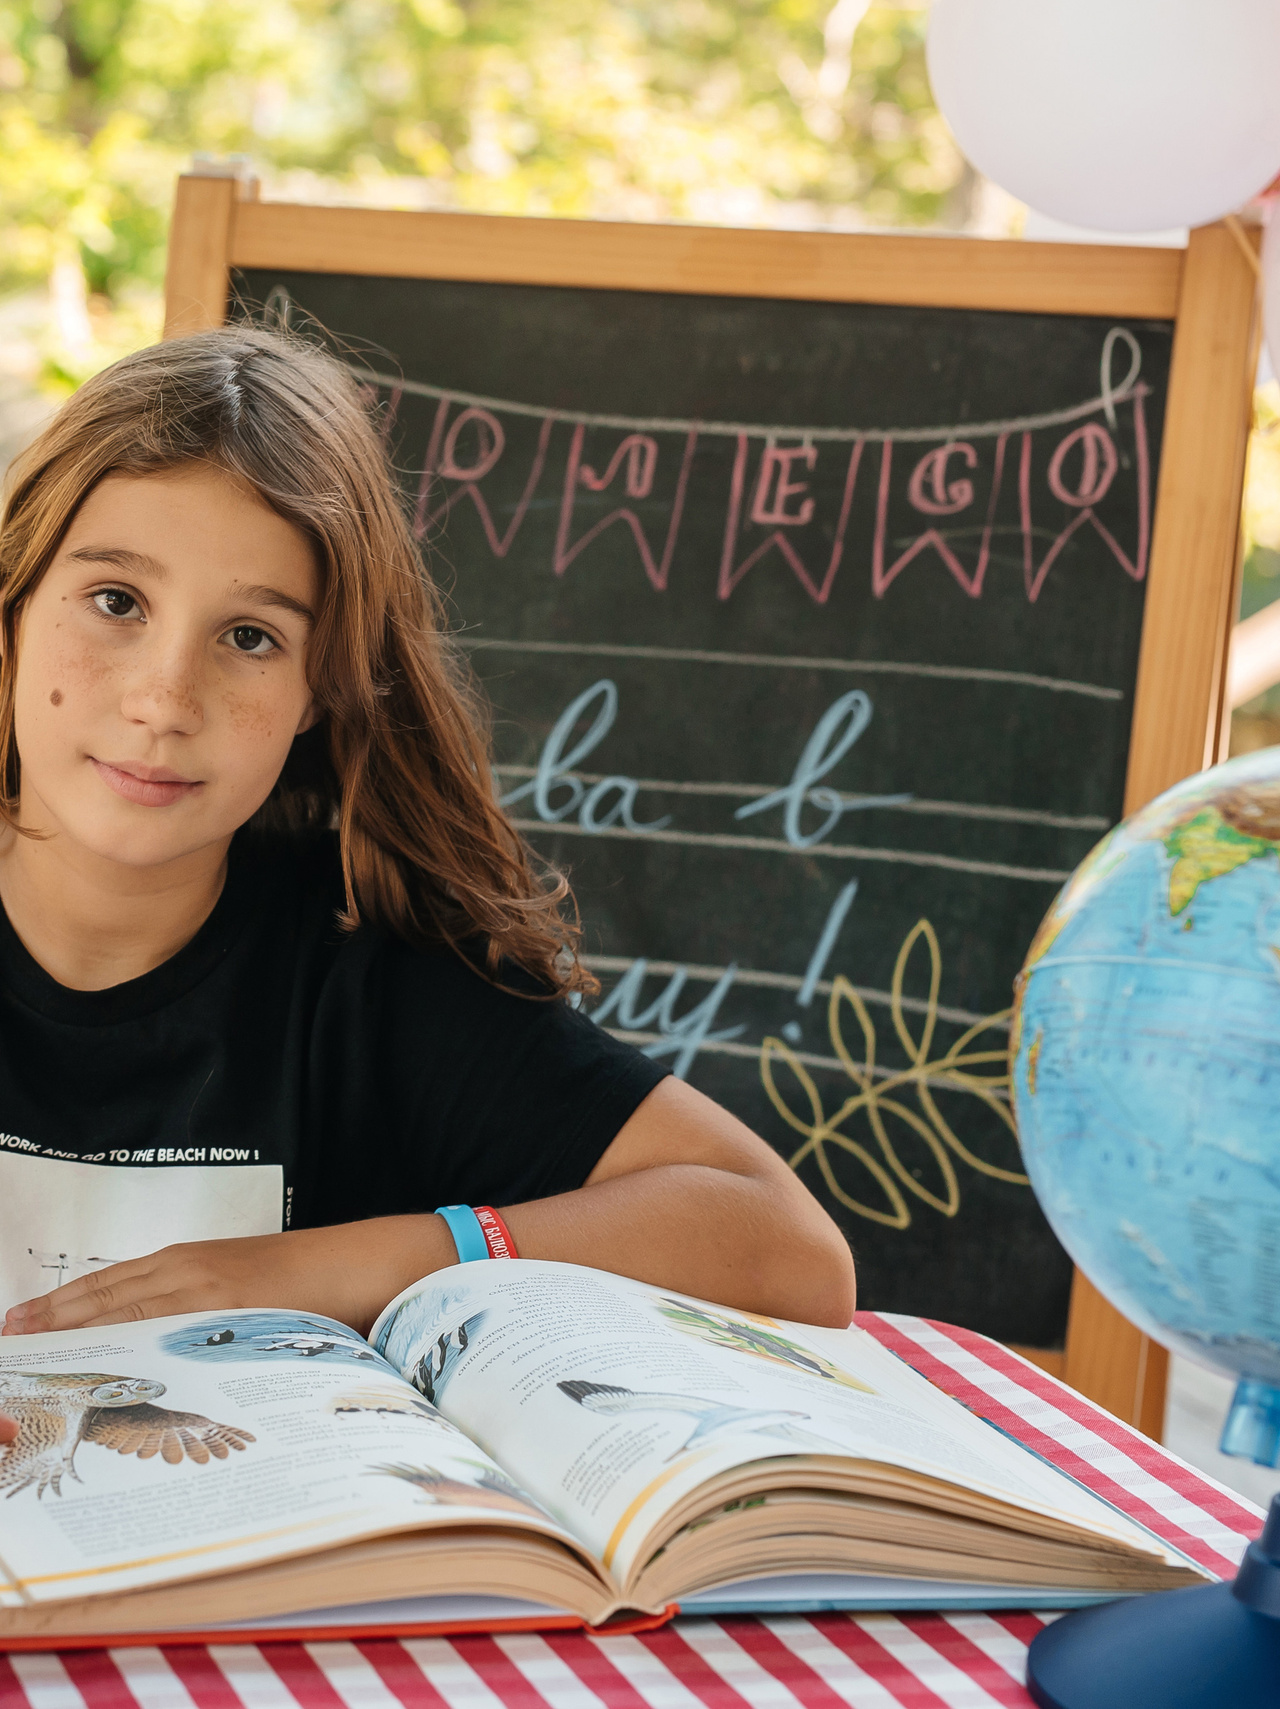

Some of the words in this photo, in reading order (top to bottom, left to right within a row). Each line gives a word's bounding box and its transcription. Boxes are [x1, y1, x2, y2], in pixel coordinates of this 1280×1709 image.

[42, 1148, 78, 1160] AND
[81, 1152, 106, 1162] GO
[109, 1149, 130, 1162] TO
[131, 1148, 156, 1162] THE
[157, 1148, 206, 1162] BEACH
[210, 1148, 250, 1161] NOW
[476, 1210, 497, 1226] МЫС
[477, 1319, 522, 1347] плавают
[458, 1334, 506, 1376] помощью
[478, 1350, 505, 1373] воды.
[512, 1343, 545, 1365] живут
[509, 1355, 562, 1392] поплавки.
[519, 1382, 544, 1406] воды
